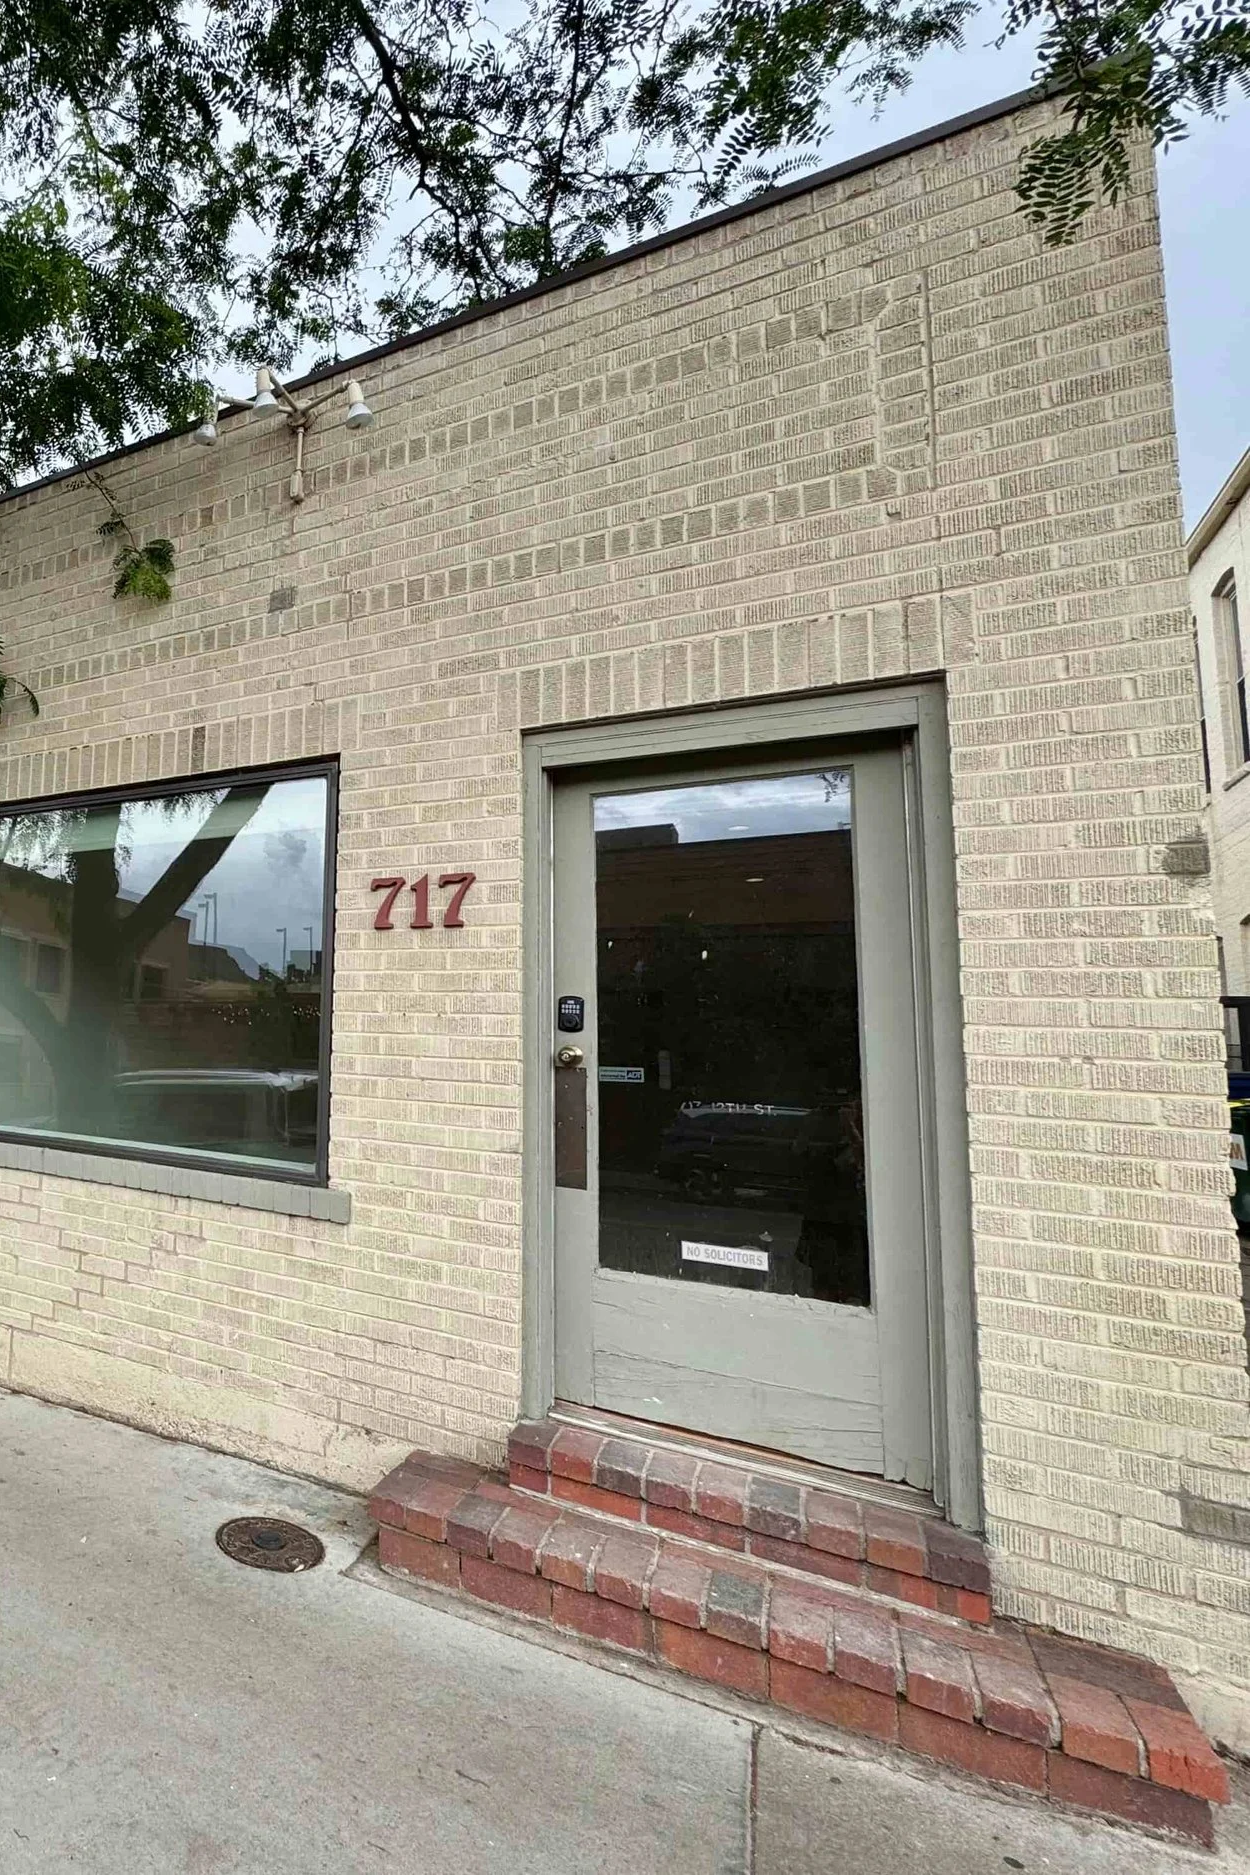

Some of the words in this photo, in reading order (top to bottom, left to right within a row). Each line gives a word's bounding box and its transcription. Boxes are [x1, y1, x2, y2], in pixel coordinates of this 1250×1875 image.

[370, 872, 477, 930] 717
[627, 1071, 641, 1079] ADT
[753, 1103, 777, 1116] ST.
[686, 1246, 701, 1257] NO
[704, 1248, 763, 1266] SOLICITORS
